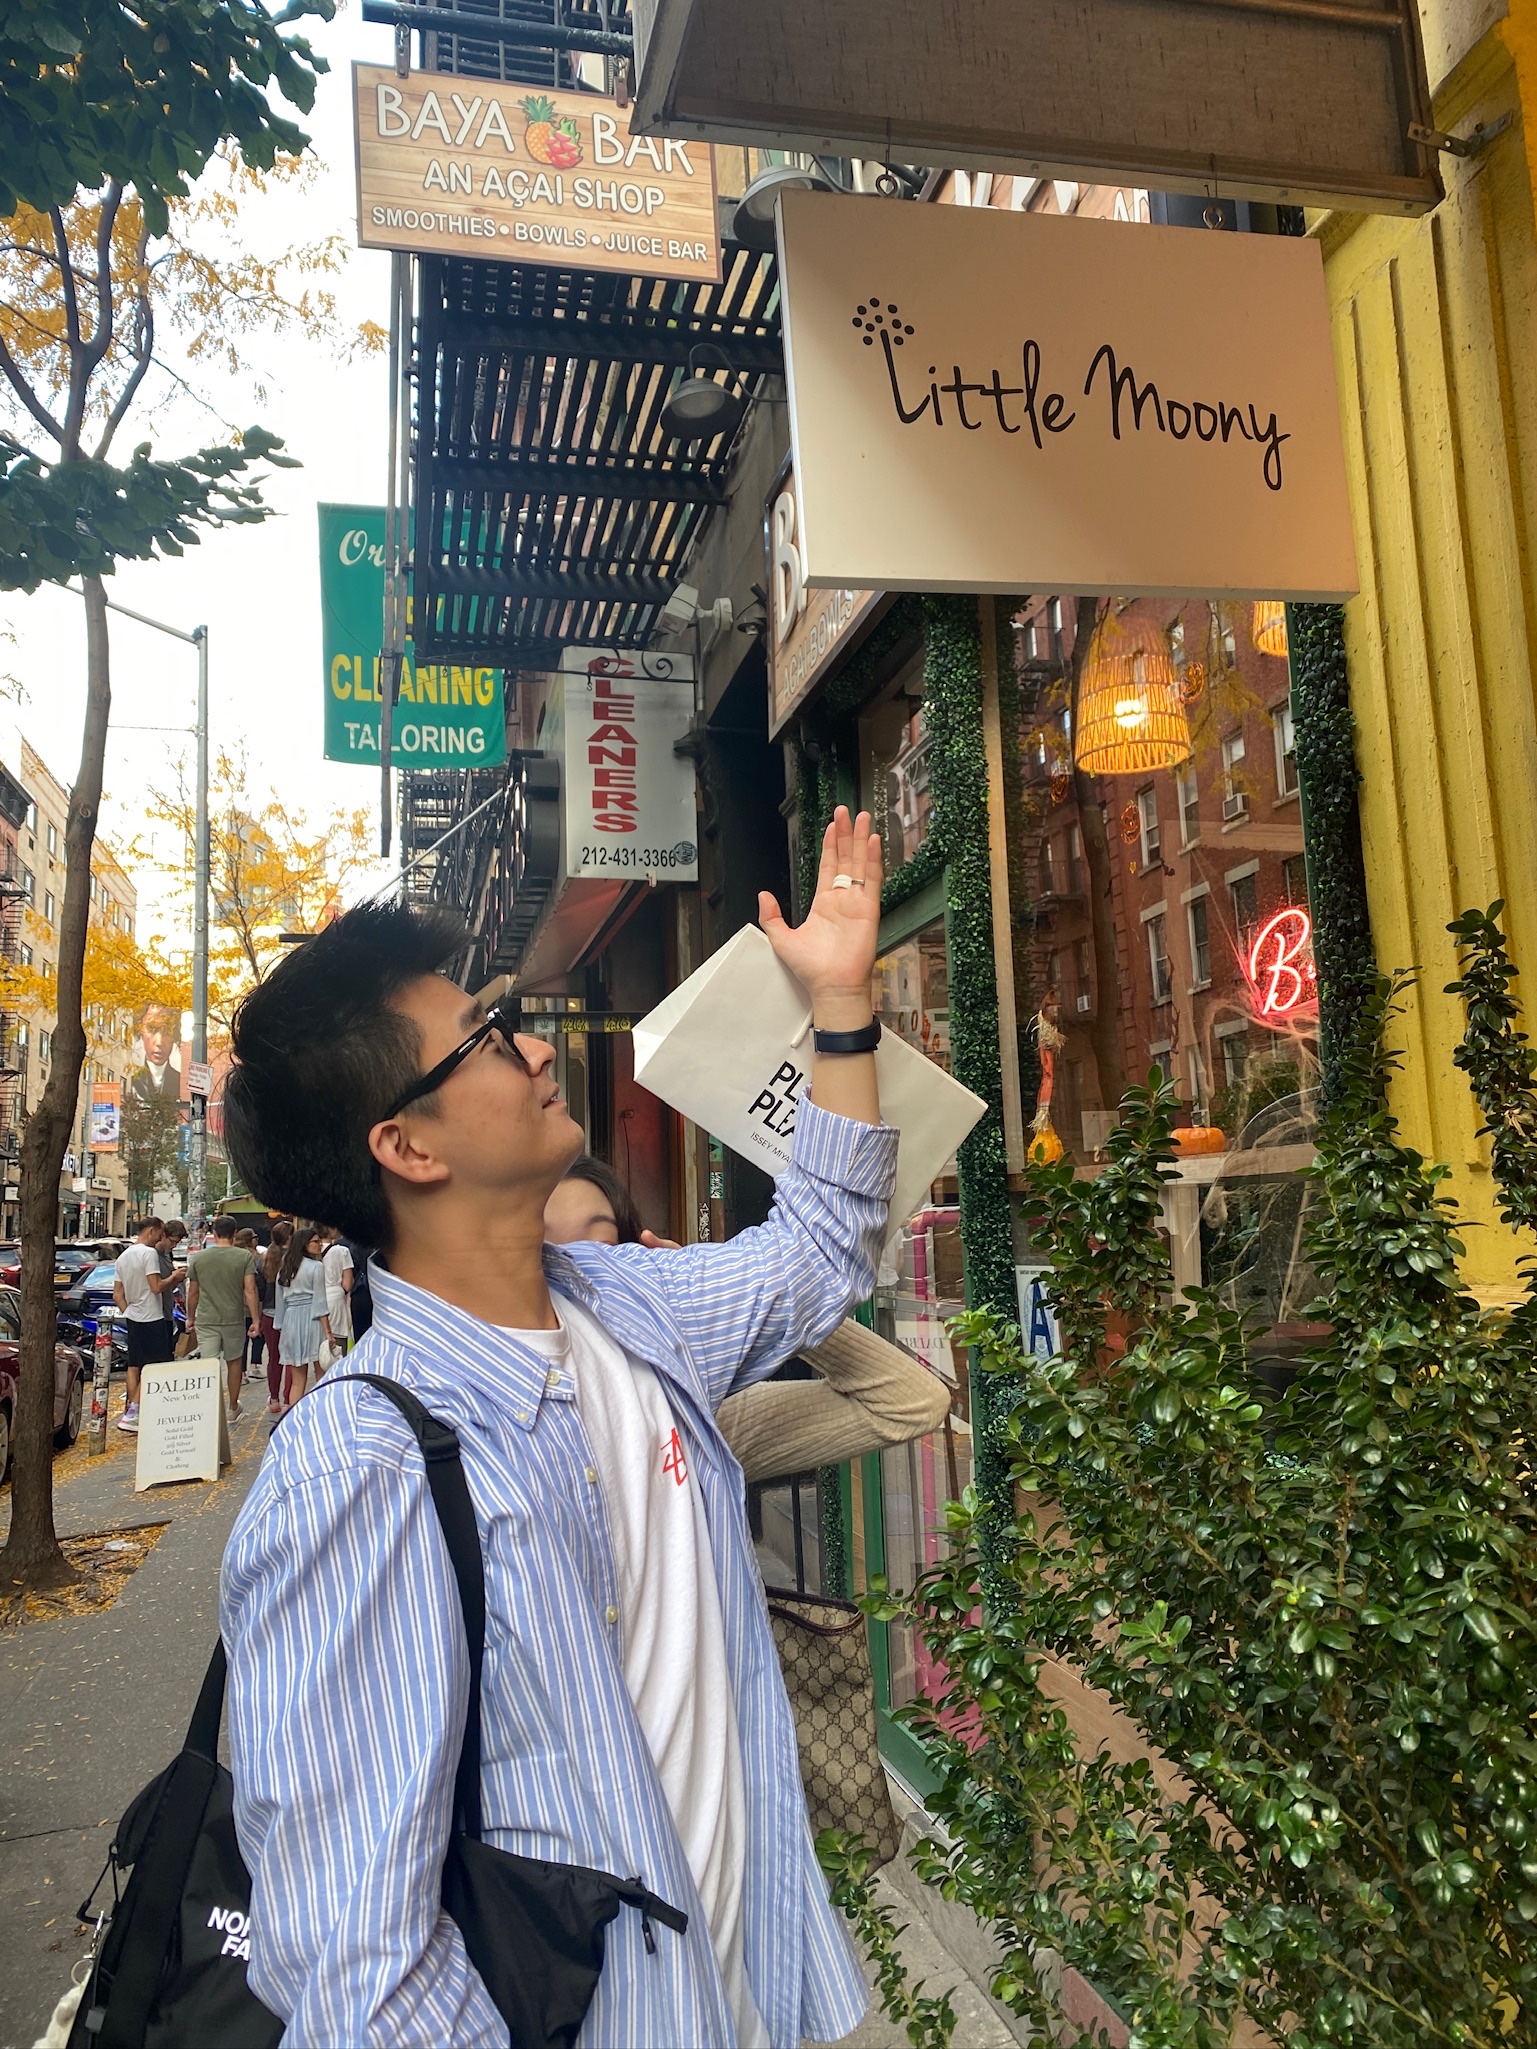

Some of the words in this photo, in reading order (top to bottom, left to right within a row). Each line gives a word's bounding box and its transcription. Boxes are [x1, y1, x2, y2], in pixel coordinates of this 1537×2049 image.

[377, 83, 516, 152] BAYA
[592, 112, 695, 176] BAR
[423, 159, 473, 195] AN
[482, 166, 563, 208] AÇAI
[573, 177, 665, 216] SHOP
[372, 205, 497, 238] SMOOTHIES
[514, 221, 587, 248] BOWLS
[604, 232, 663, 256] JUICE
[668, 239, 708, 262] BAR
[881, 329, 1076, 449] Little
[1084, 343, 1291, 491] Moony
[586, 657, 640, 833] CLEANERS
[582, 846, 677, 868] 212-431-3366
[769, 1061, 804, 1105] PL
[750, 1131, 773, 1150] ISSEY
[146, 1376, 216, 1395] DALBIT
[162, 1396, 181, 1404] New
[182, 1393, 201, 1402] York
[156, 1413, 204, 1426] JEWELRY
[221, 1935, 251, 1962] FA
